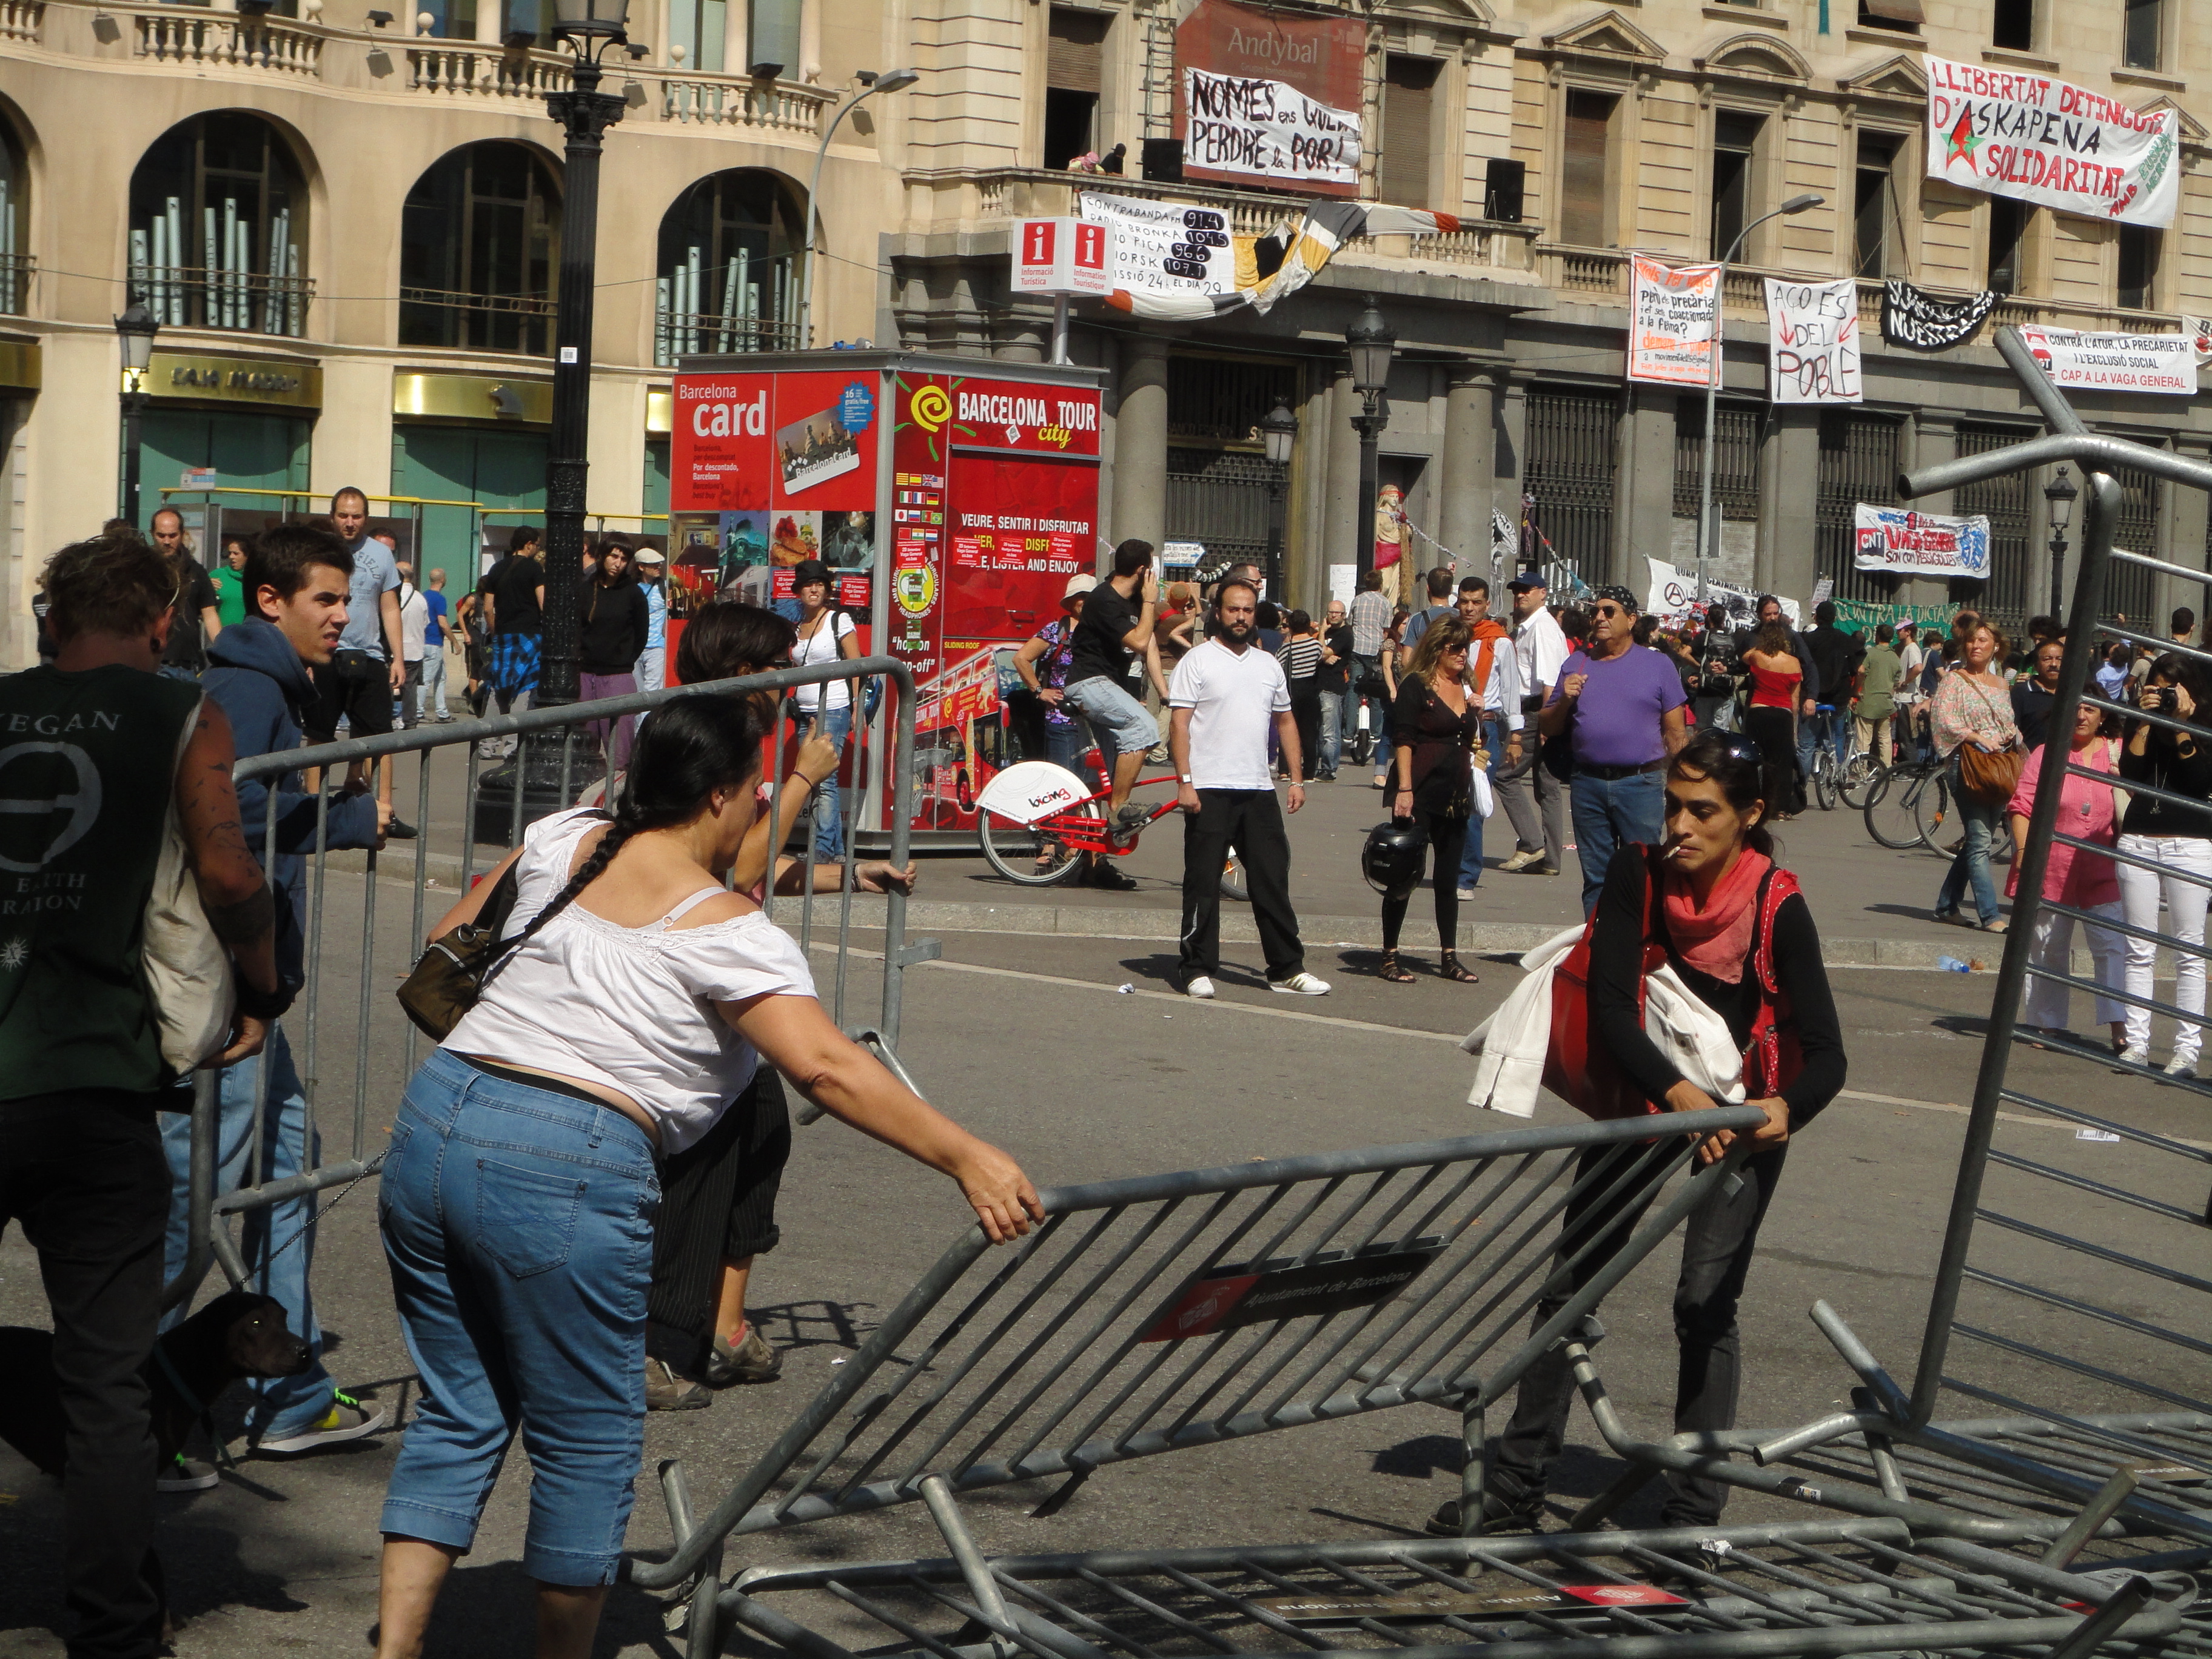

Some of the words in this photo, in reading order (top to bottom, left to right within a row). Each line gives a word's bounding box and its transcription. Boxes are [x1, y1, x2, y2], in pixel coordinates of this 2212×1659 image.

[1227, 27, 1318, 65] Andybal
[1192, 72, 1275, 121] NOMÉS
[1278, 112, 1296, 124] ens
[1932, 62, 2051, 107] LLIBERTAT
[2060, 85, 2166, 135] DETINGUTS
[1192, 119, 1268, 169] PERDRE
[1292, 132, 1344, 174] POR!
[1986, 144, 2125, 199] SOLIDARITAT
[2109, 184, 2137, 217] AMB
[1087, 196, 1169, 223] CONTRABANDA
[1188, 212, 1219, 230] 91.4
[1128, 224, 1182, 241] BRONKA
[1187, 231, 1228, 247] 104.5
[1134, 236, 1167, 253] PICA
[1175, 245, 1206, 261] 96.6
[1021, 267, 1054, 276] Informació
[1073, 268, 1107, 281] Information
[1165, 258, 1202, 278] 107.1
[1021, 277, 1047, 286] Turística
[1073, 278, 1105, 290] Touristique
[1173, 278, 1183, 288] EL
[1187, 280, 1201, 290] DIA
[1204, 281, 1222, 297] 29
[1644, 305, 1653, 314] et
[1818, 284, 1849, 320] ÉS
[1639, 317, 1644, 326] a
[1647, 315, 1654, 328] la
[1658, 319, 1689, 339] feina?
[1794, 323, 1834, 347] DEL
[2049, 334, 2083, 347] CONTRA
[2085, 337, 2119, 352] L'ATUR,
[2119, 339, 2131, 350] LA
[2133, 340, 2188, 353] PRECARIETAT
[1644, 352, 1649, 361] a
[2038, 358, 2051, 369] GT
[2081, 353, 2127, 367] L'EXCLUSIÓ
[2129, 357, 2159, 369] SOCIAL
[1777, 346, 1860, 400] POBLE
[2061, 369, 2082, 382] CAP
[2085, 371, 2092, 383] A
[2094, 372, 2108, 384] LA
[2110, 372, 2137, 386] VAGA
[2140, 375, 2187, 389] GENERAL
[680, 383, 737, 400] Barcelona
[845, 388, 854, 398] 16
[693, 390, 766, 437] card
[959, 392, 1048, 427] BARCELONA
[1057, 401, 1096, 431] TOUR
[1038, 423, 1071, 449] city
[705, 463, 739, 472] descontado,
[795, 446, 851, 478] BarcelonaCard
[962, 514, 996, 531] VEURE,
[998, 516, 1031, 531] SENTIR
[1033, 518, 1037, 531] I
[1039, 519, 1089, 535] DISFRUTAR
[1862, 532, 1882, 549] CNT
[1027, 558, 1047, 572] AND
[1049, 560, 1079, 574] ENJOY
[1886, 550, 1902, 563] SON
[899, 606, 931, 619] HEADPHONES
[1834, 599, 1895, 625] CONTRA
[1898, 605, 1913, 624] LA
[0, 711, 122, 735] EGAN
[1028, 788, 1071, 808] bicing
[1244, 1283, 1326, 1307] Ajuntament
[1327, 1282, 1342, 1293] de
[1349, 1271, 1412, 1292] Barcelona
